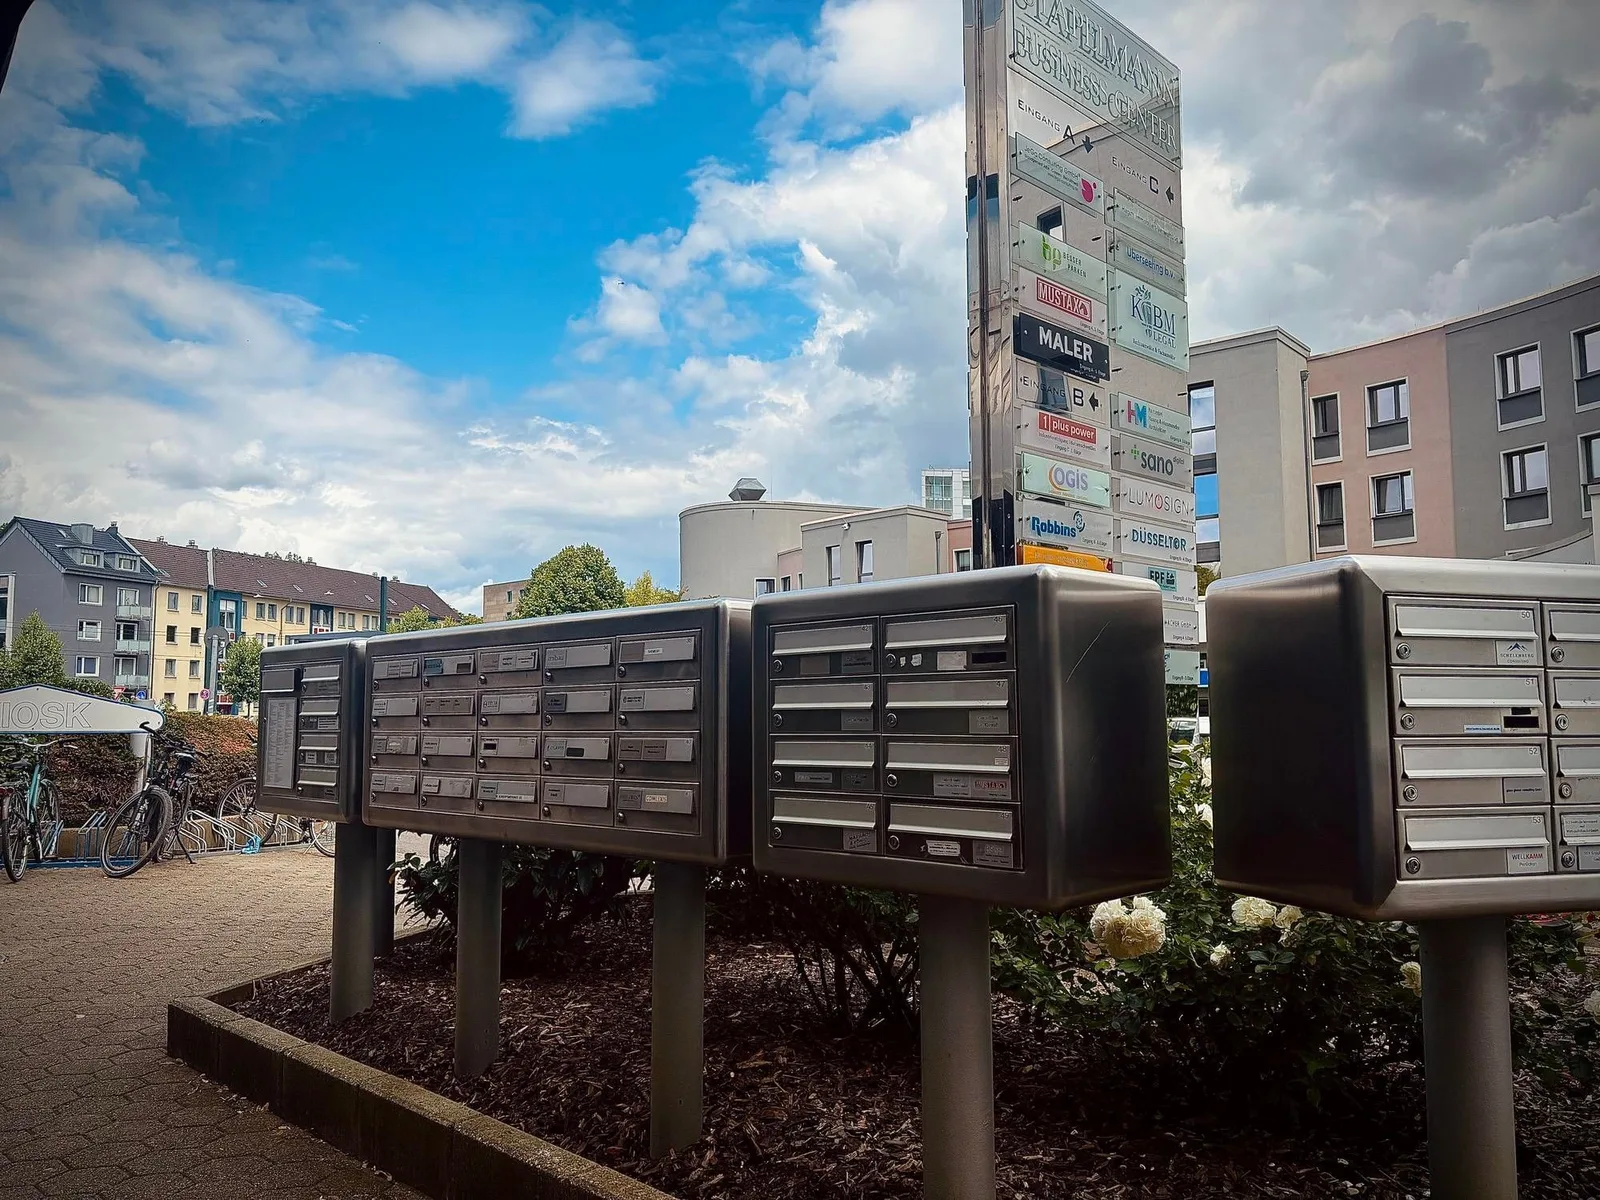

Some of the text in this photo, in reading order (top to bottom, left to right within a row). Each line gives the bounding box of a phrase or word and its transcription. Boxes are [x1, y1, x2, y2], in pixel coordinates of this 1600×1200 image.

[1018, 99, 1075, 145] EINGANG A
[1112, 156, 1158, 194] EINGANG C
[1040, 283, 1081, 314] MUSTAX
[1039, 326, 1093, 363] MALER
[1153, 330, 1176, 348] LEGAL
[1023, 376, 1083, 406] EINGANG B
[1043, 415, 1094, 439] 1 plus power
[1141, 451, 1173, 475] sano
[1129, 488, 1189, 515] LUMOSIGN
[1031, 516, 1076, 537] Robbins
[1132, 526, 1186, 551] DÜSSELTOR
[1521, 611, 1531, 619] 50
[0, 701, 91, 728] IOSK
[1529, 747, 1538, 755] 52
[1532, 816, 1541, 824] 53
